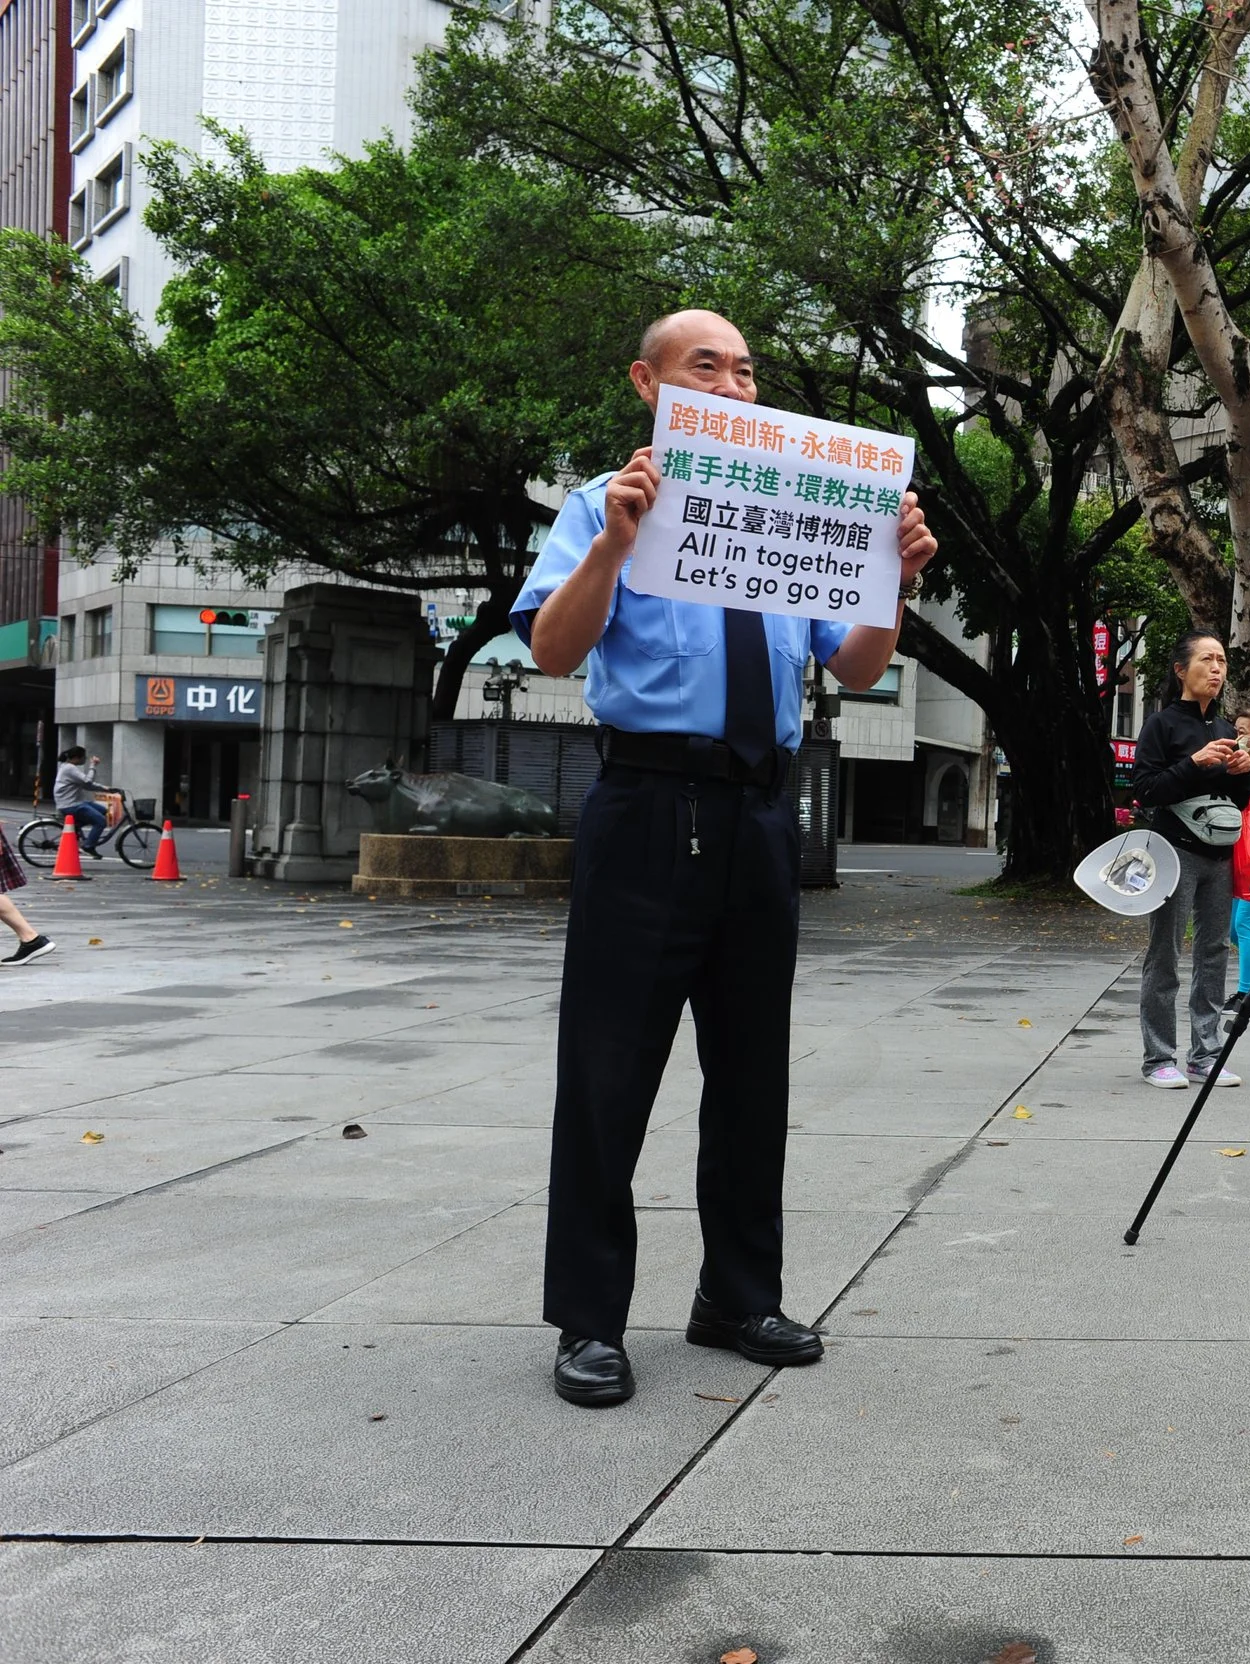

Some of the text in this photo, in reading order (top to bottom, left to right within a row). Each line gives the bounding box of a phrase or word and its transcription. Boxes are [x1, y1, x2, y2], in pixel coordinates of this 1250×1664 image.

[682, 494, 873, 552] 國立臺灣博物館
[677, 531, 865, 579] All in together
[674, 558, 861, 610] Let's go go go
[186, 684, 256, 714] 中化
